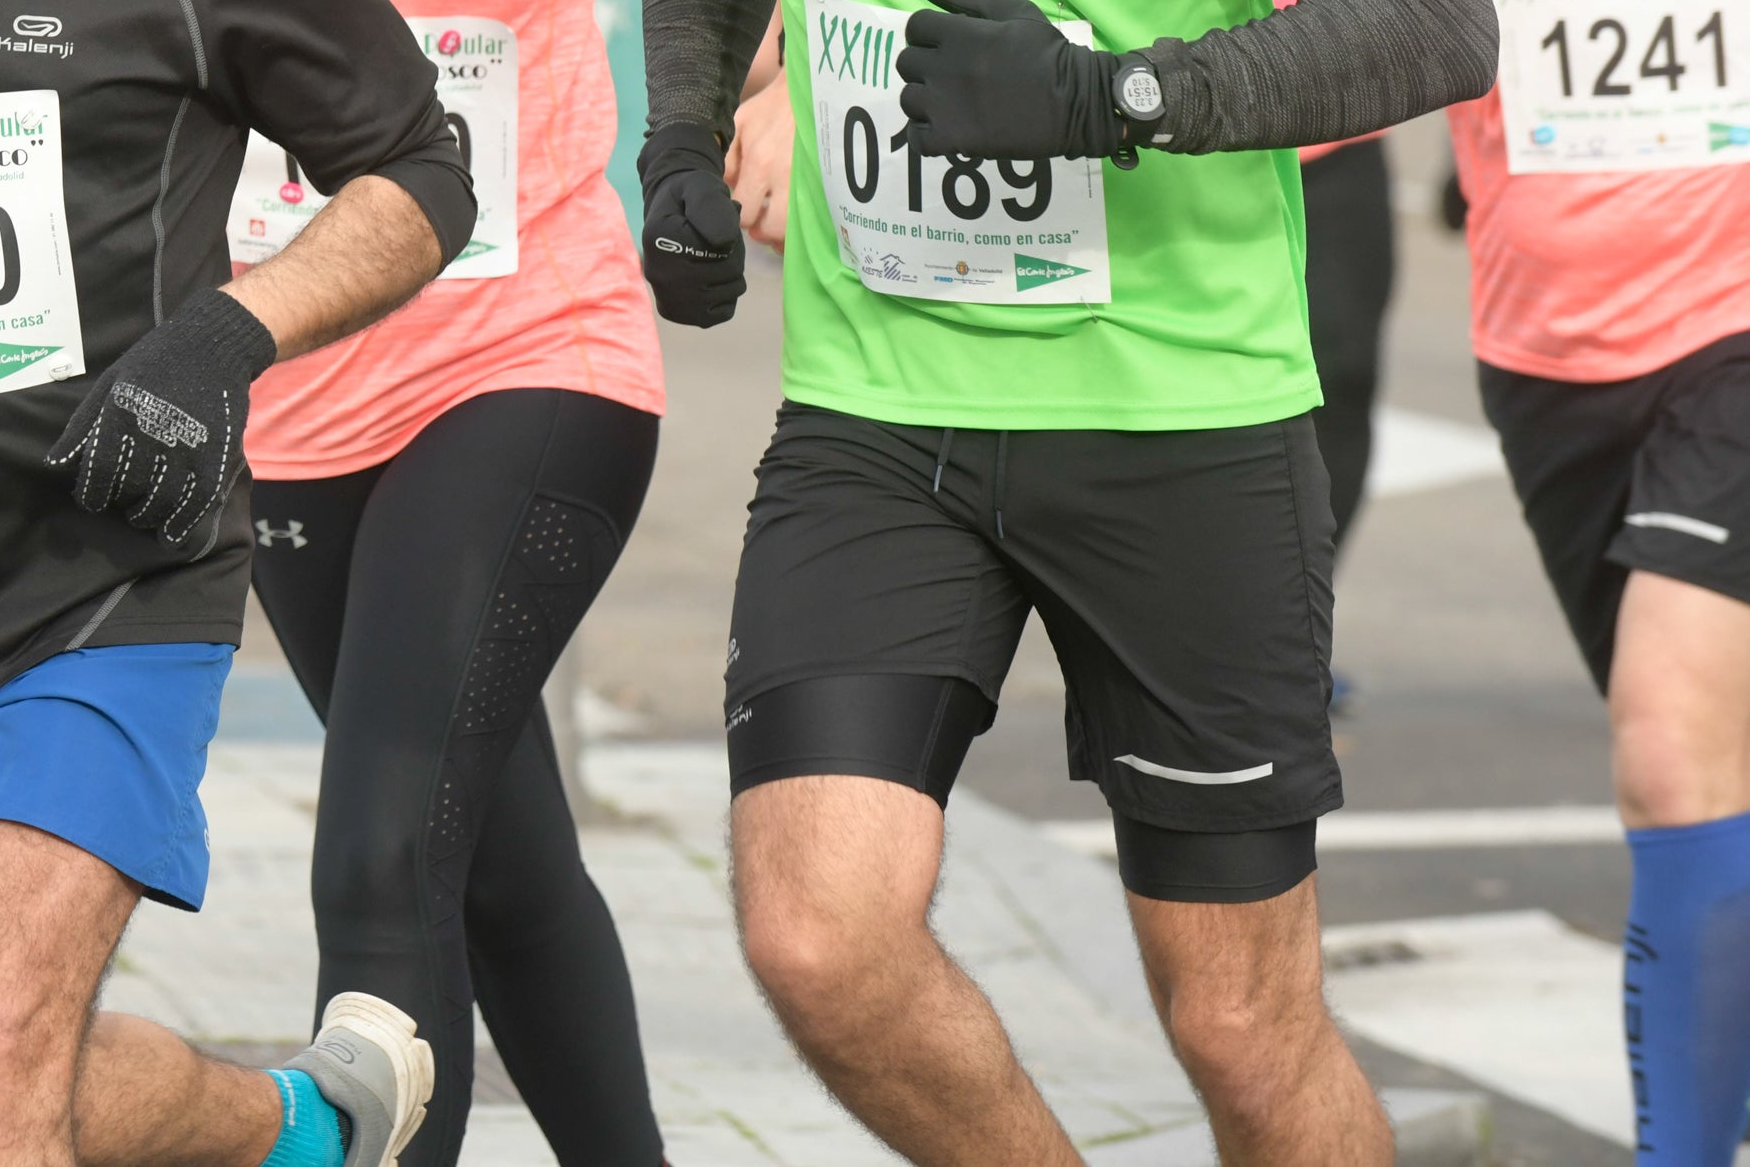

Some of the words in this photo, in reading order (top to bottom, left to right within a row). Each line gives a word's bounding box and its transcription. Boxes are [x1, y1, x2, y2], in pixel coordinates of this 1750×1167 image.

[424, 33, 508, 58] Pular
[818, 11, 895, 90] XXIII
[1540, 10, 1728, 98] 1241
[842, 105, 1054, 222] 0189
[838, 204, 888, 234] "Corriendo
[891, 223, 907, 236] en
[910, 224, 923, 238] el
[926, 225, 969, 246] barrio,
[974, 234, 1012, 246] como
[1016, 233, 1034, 245] en
[1038, 229, 1080, 244] casa"
[10, 309, 51, 329] casa"
